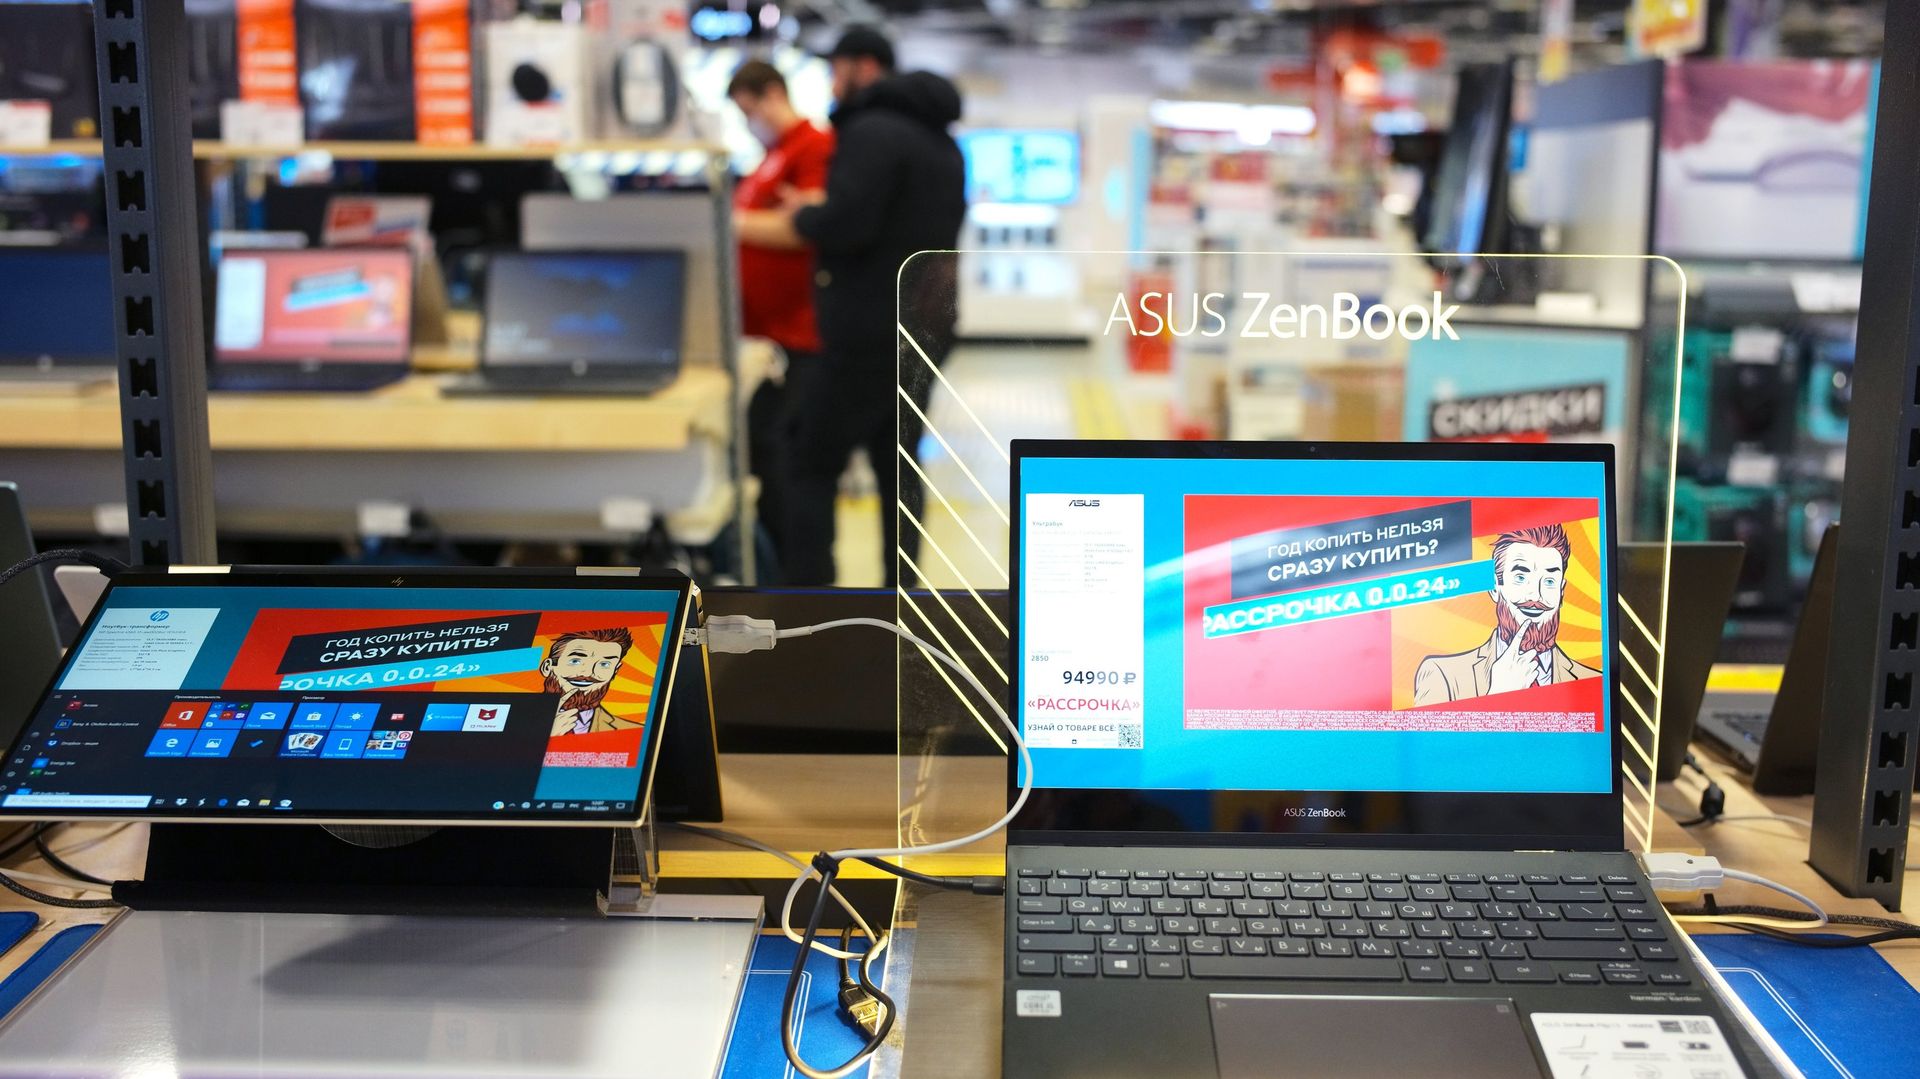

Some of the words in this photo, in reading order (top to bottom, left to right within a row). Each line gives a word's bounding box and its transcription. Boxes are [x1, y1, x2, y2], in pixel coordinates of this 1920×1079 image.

[1104, 292, 1226, 337] ASUS
[1240, 291, 1461, 341] ZenBook
[1268, 541, 1302, 559] ГОД
[1305, 531, 1373, 553] КОПИТЬ
[1377, 517, 1443, 541] НЕЛЬЗЯ
[1267, 556, 1337, 582] СРАЗУ
[1342, 539, 1439, 570] КУПИТЬ?
[325, 637, 361, 649] ГОД
[364, 631, 435, 645] КОПИТЬ
[439, 623, 509, 638] НЕЛЬЗЯ
[319, 646, 394, 663] СРАЗУ
[396, 636, 500, 655] КУПИТЬ?
[1063, 671, 1119, 685] 94990
[1028, 698, 1140, 711] «РАССРОЧКА»
[1028, 723, 1055, 731] УЗНАЙ
[1284, 808, 1306, 817] ASUS
[1307, 808, 1346, 817] ZenBook
[1108, 939, 1117, 947] Z
[1192, 940, 1204, 948] C
